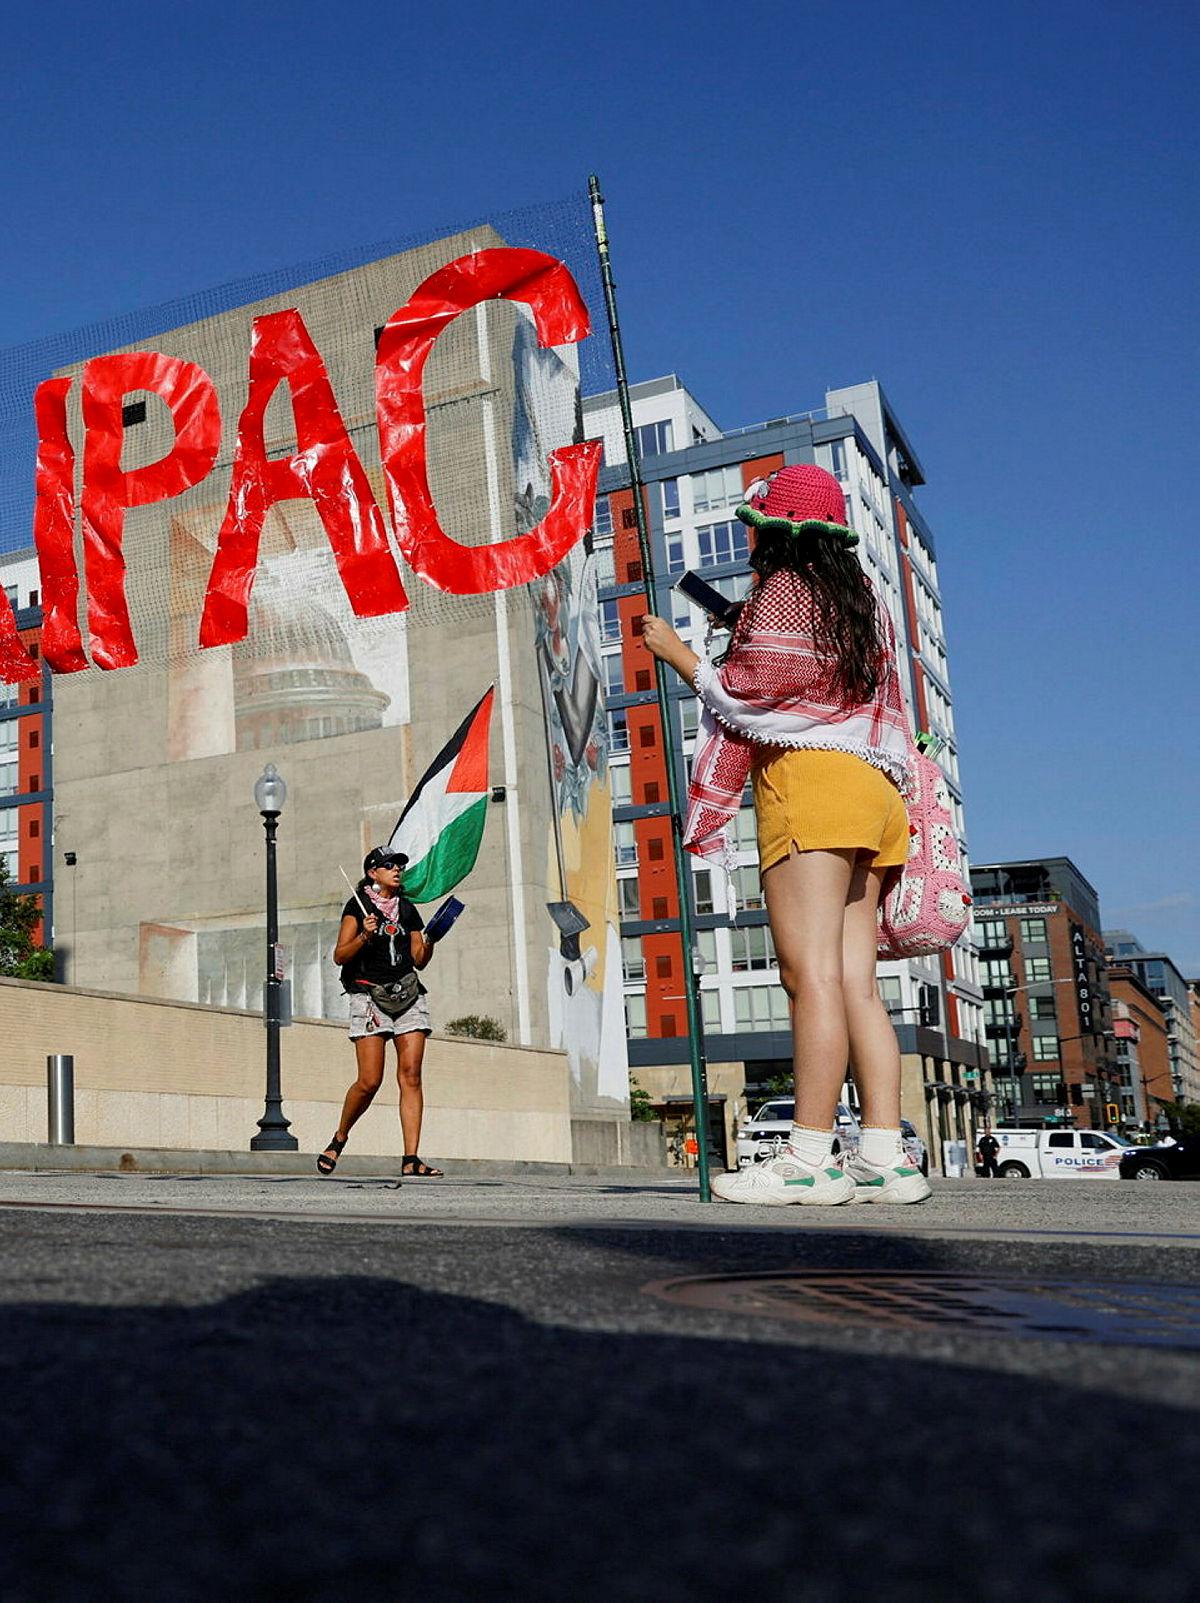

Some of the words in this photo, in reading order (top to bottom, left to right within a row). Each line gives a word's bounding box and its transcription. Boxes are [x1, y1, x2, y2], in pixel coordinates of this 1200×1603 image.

[973, 909, 994, 917] OOM
[1000, 907, 1027, 915] LEASE
[1028, 905, 1058, 914] TODAY
[1055, 1157, 1104, 1166] POLICE
